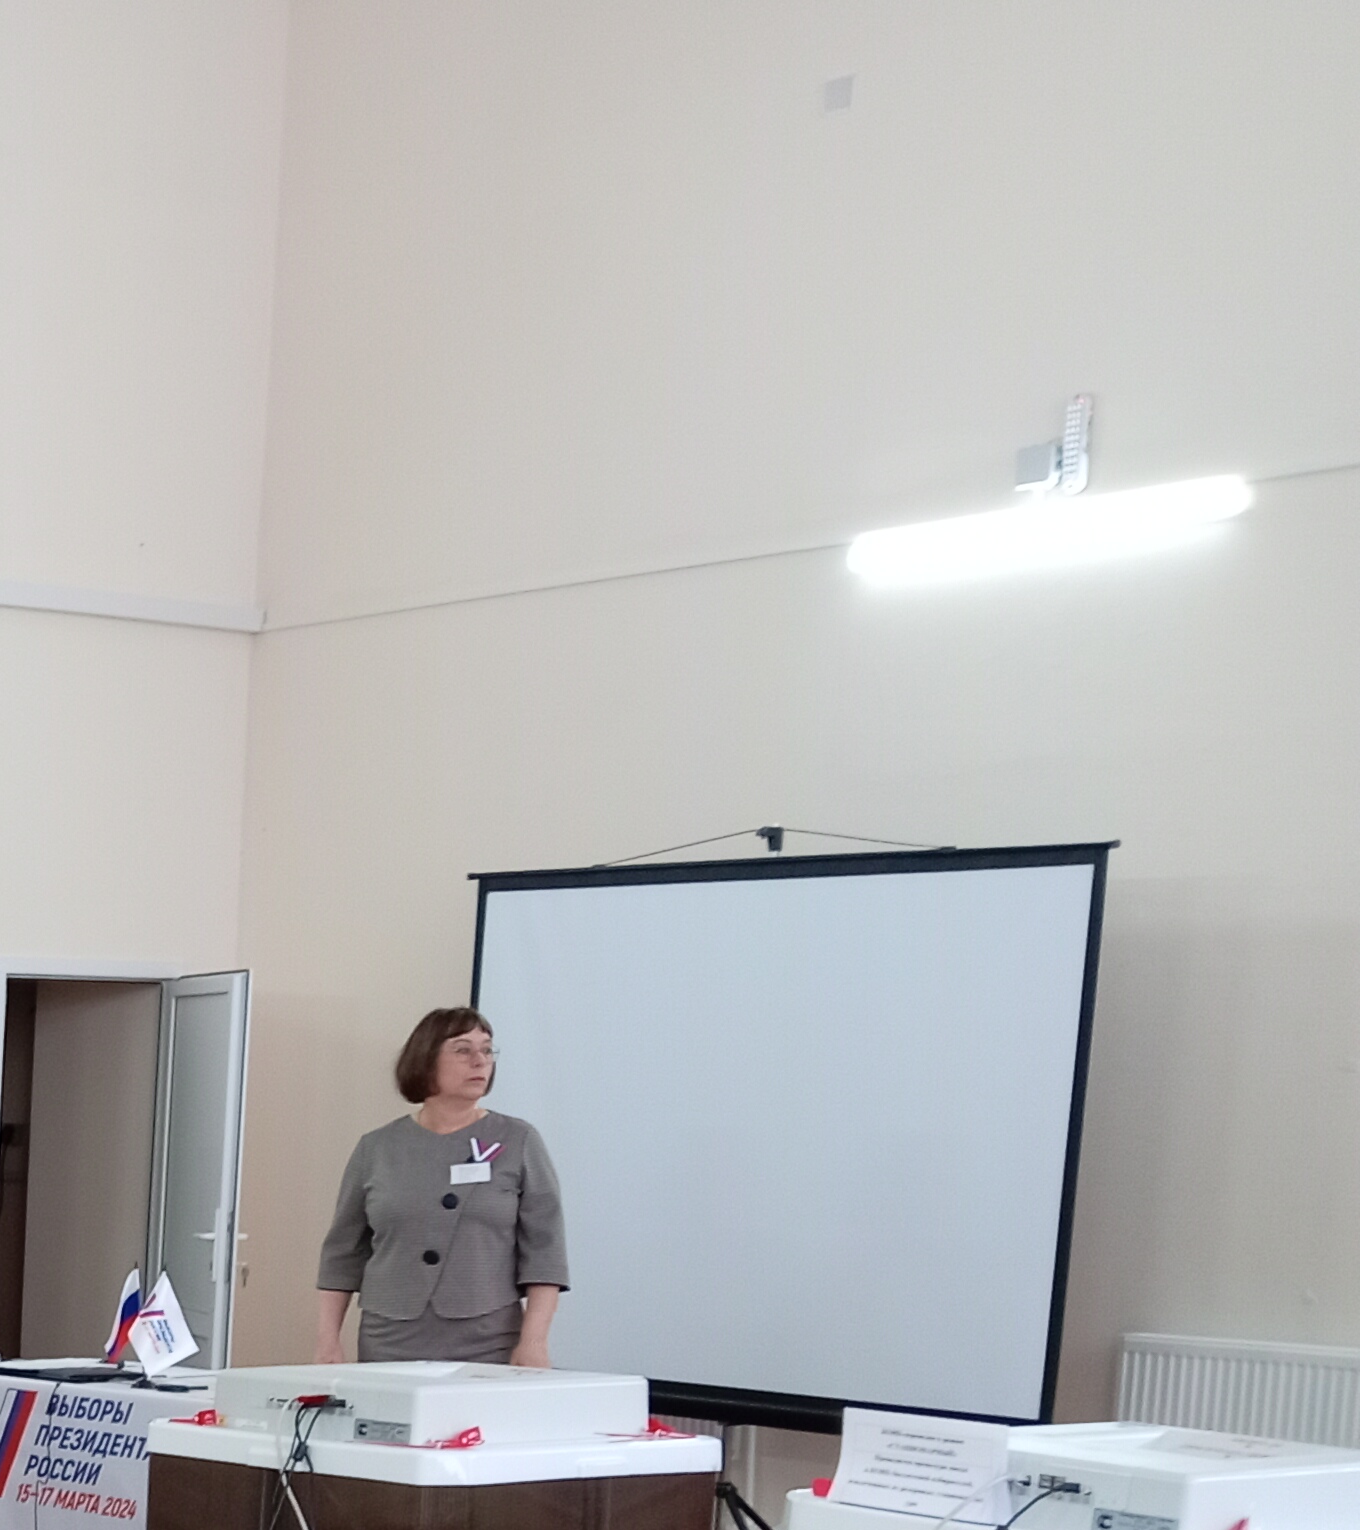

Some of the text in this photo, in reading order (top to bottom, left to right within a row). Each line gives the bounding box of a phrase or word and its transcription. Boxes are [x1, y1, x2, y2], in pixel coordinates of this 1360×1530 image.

[46, 1393, 134, 1425] ВЫБОРЫ
[33, 1423, 151, 1462] ПРЕЗИДЕНТ
[23, 1454, 103, 1486] РОССИИ
[53, 1488, 102, 1514] МАРТА
[101, 1496, 138, 1521] 2024
